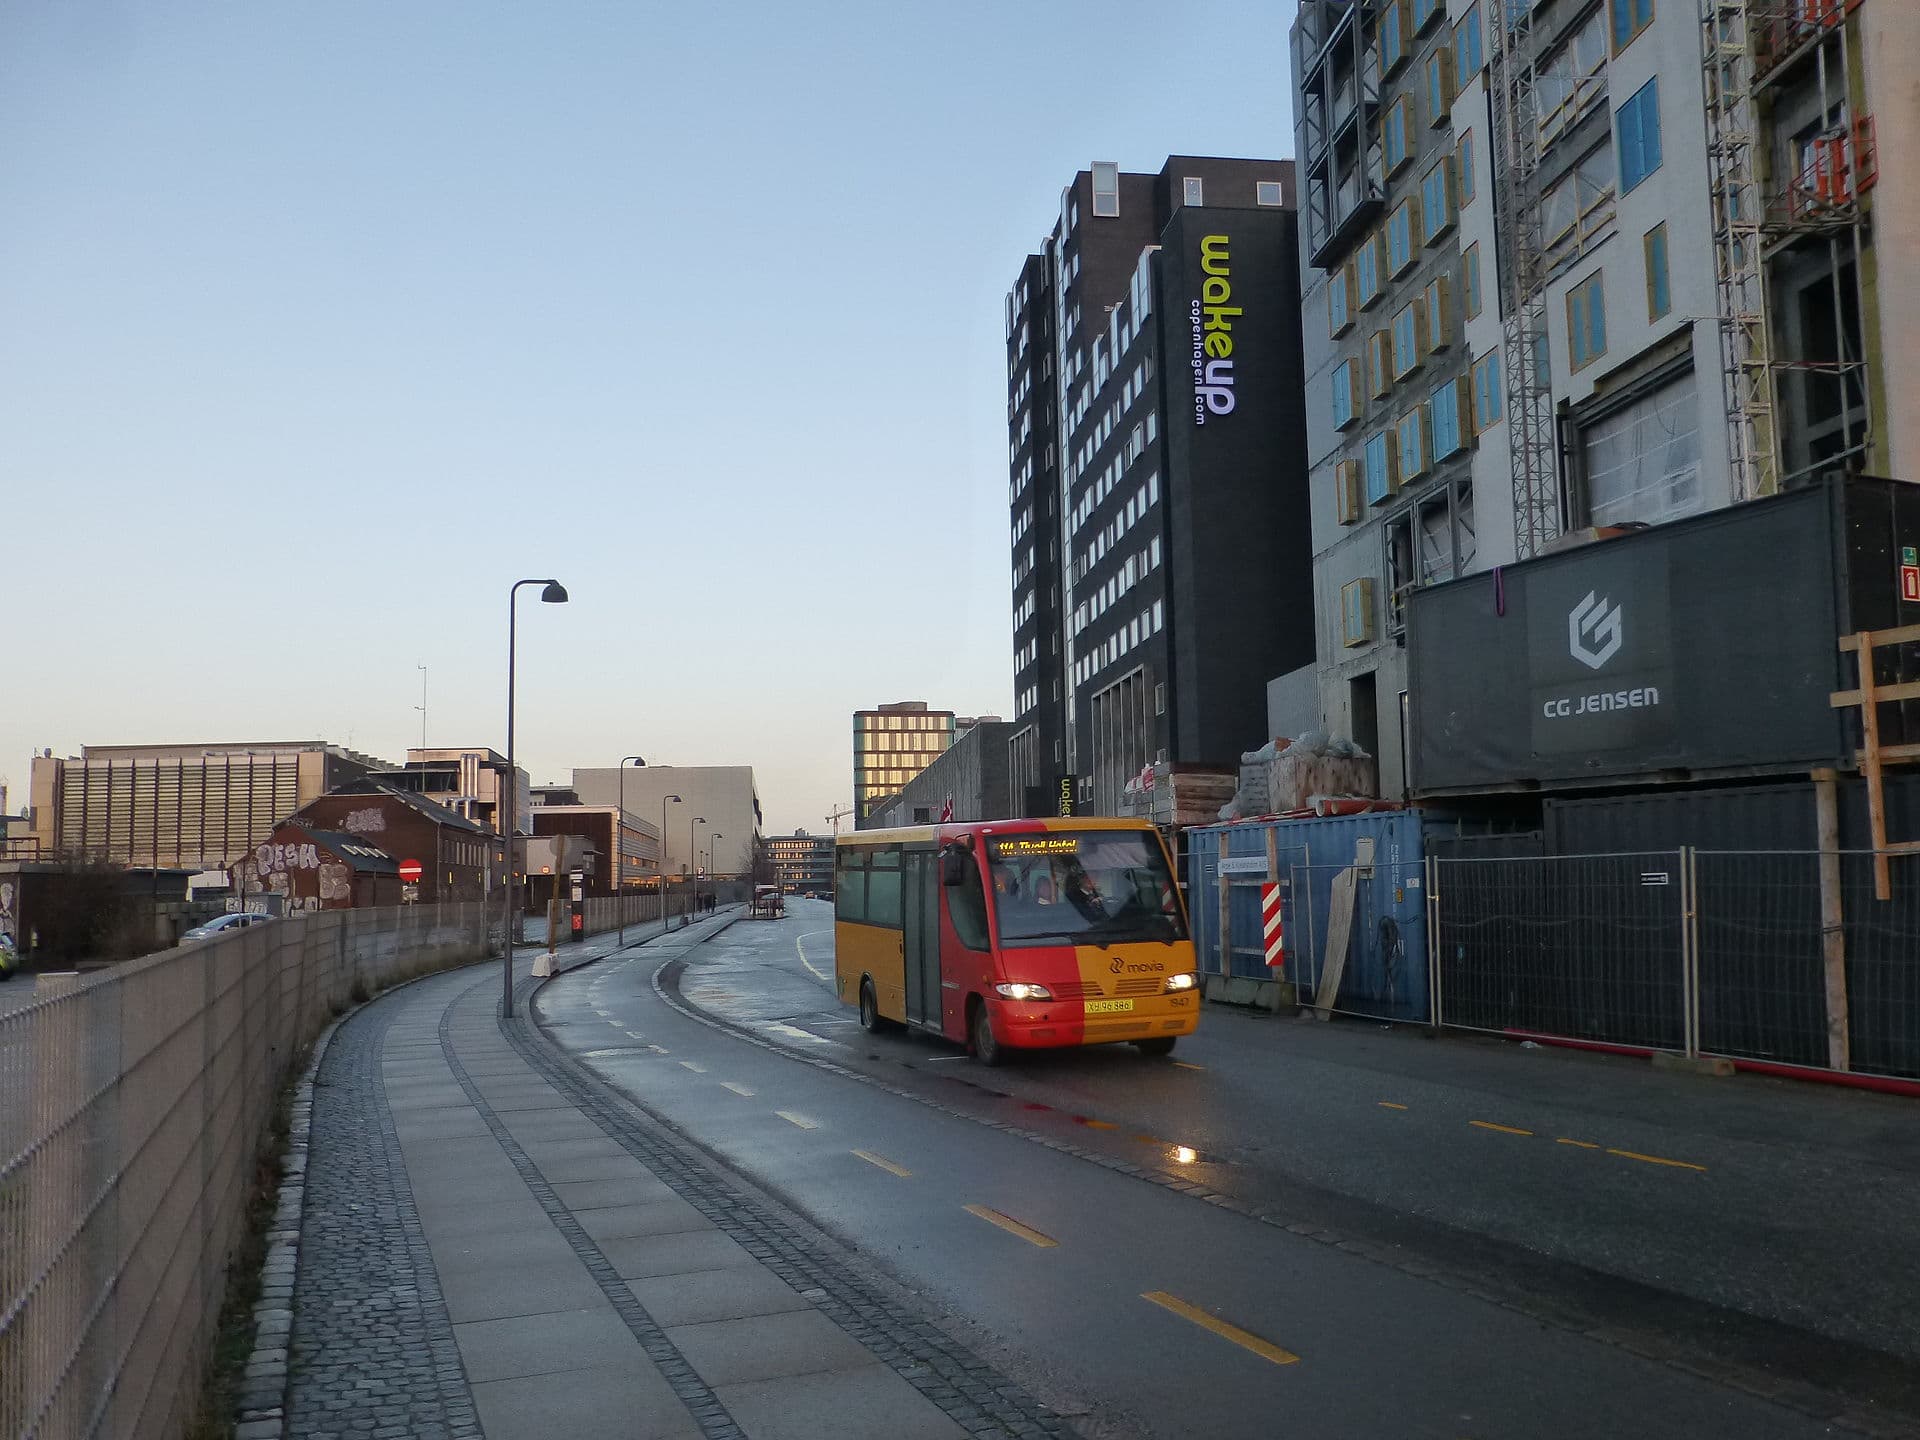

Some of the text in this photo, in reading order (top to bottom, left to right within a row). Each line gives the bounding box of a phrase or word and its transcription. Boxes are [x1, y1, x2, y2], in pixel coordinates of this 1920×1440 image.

[1543, 687, 1659, 718] CG JENSEN
[1127, 961, 1165, 973] movia
